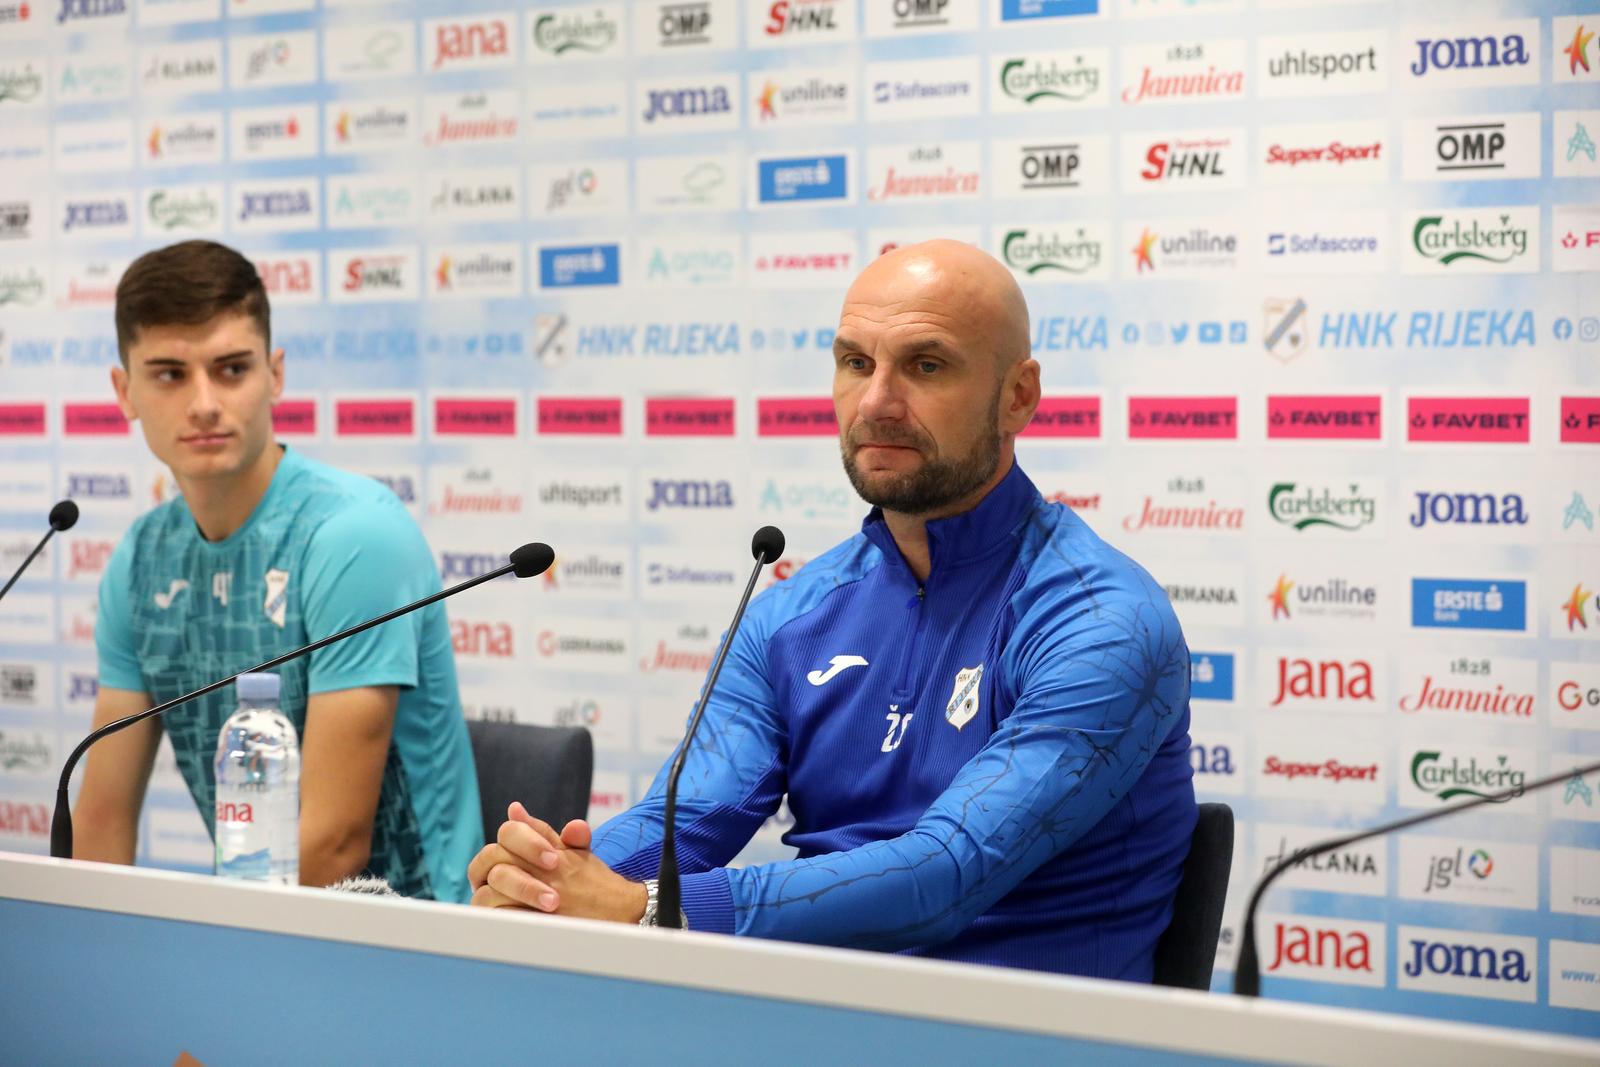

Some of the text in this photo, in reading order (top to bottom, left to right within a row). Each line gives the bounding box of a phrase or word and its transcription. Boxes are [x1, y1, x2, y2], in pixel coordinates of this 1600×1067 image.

[534, 10, 617, 53] Carlsberg
[660, 13, 711, 36] OMP
[765, 1, 838, 35] SHNL
[1001, 57, 1099, 101] Carlsberg
[1269, 47, 1377, 82] uhlsport
[782, 80, 846, 102] uniline
[1122, 64, 1244, 103] Jamnica
[1142, 142, 1224, 180] SHNL
[1266, 142, 1381, 166] SuperSport
[1437, 133, 1505, 161] OMP
[1022, 154, 1079, 179] OMP
[867, 167, 979, 201] Jamnica
[1003, 229, 1101, 273] Carlsberg
[1162, 230, 1236, 253] uniline
[1290, 234, 1377, 253] Sofascore
[1413, 214, 1528, 265] Carlsberg
[258, 259, 312, 294] ana
[577, 323, 740, 356] HNK RIJEKA
[1031, 317, 1108, 351] JEKA
[1318, 309, 1536, 348] HNK RIJEKA
[1031, 411, 1099, 426] AVBET
[1151, 411, 1235, 426] FAVBET
[1290, 411, 1379, 426] FAVBET
[1432, 414, 1527, 429] FAVBET
[1122, 496, 1244, 532] Jamnica
[1268, 482, 1376, 531] Carlsberg
[1165, 586, 1237, 604] ERMANIA
[1297, 580, 1376, 605] uniline
[1433, 590, 1483, 610] ERSTE
[451, 620, 514, 657] ana
[1269, 656, 1376, 707] Jana
[1449, 658, 1491, 675] 1828
[1398, 675, 1535, 717] Jamnica
[1263, 754, 1378, 781] SuperSport
[1411, 750, 1526, 803] Carlsberg
[0, 803, 49, 835] ana
[1424, 847, 1463, 893] jgl
[1267, 923, 1373, 972] Jana
